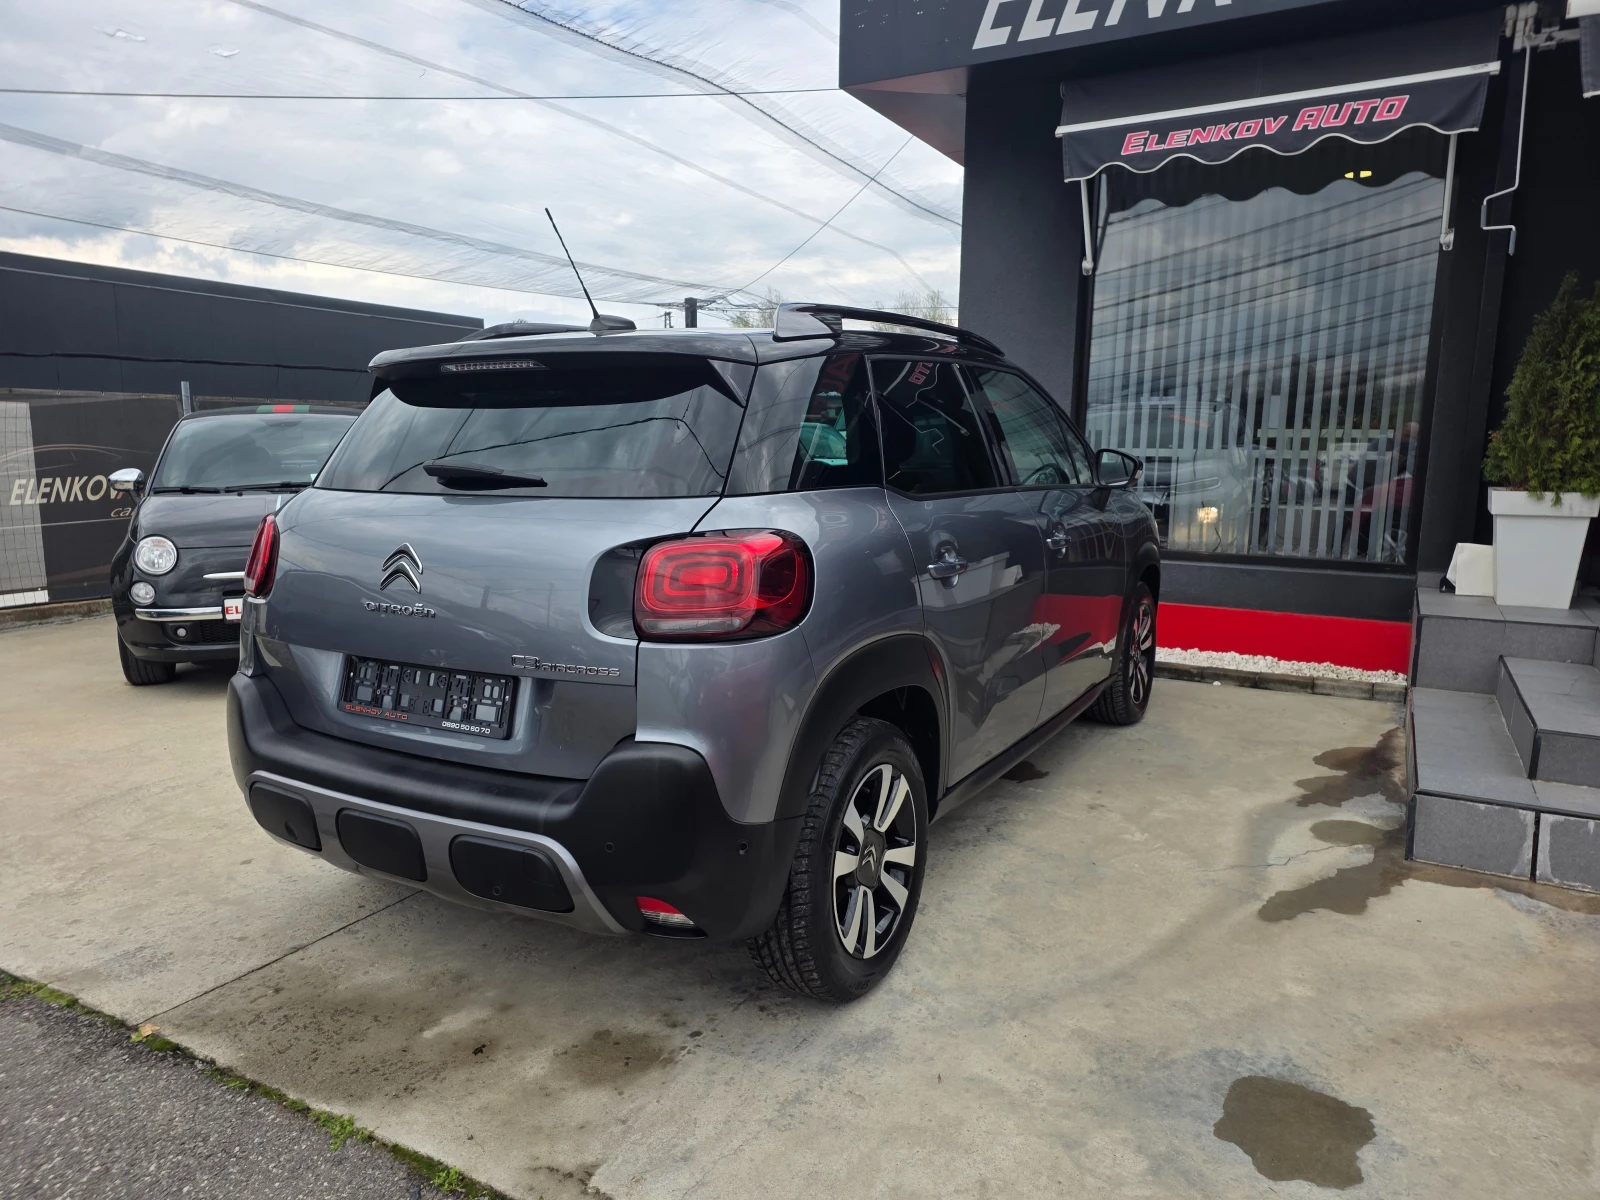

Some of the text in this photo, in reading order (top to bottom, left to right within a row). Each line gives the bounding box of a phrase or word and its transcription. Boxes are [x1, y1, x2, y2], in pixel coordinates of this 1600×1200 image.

[1121, 95, 1409, 155] ELENKOV AUTO
[111, 507, 134, 518] ca
[225, 605, 242, 615] EL
[511, 654, 620, 677] C3 AIRCROSS
[345, 703, 408, 720] ELENKOV AUTO
